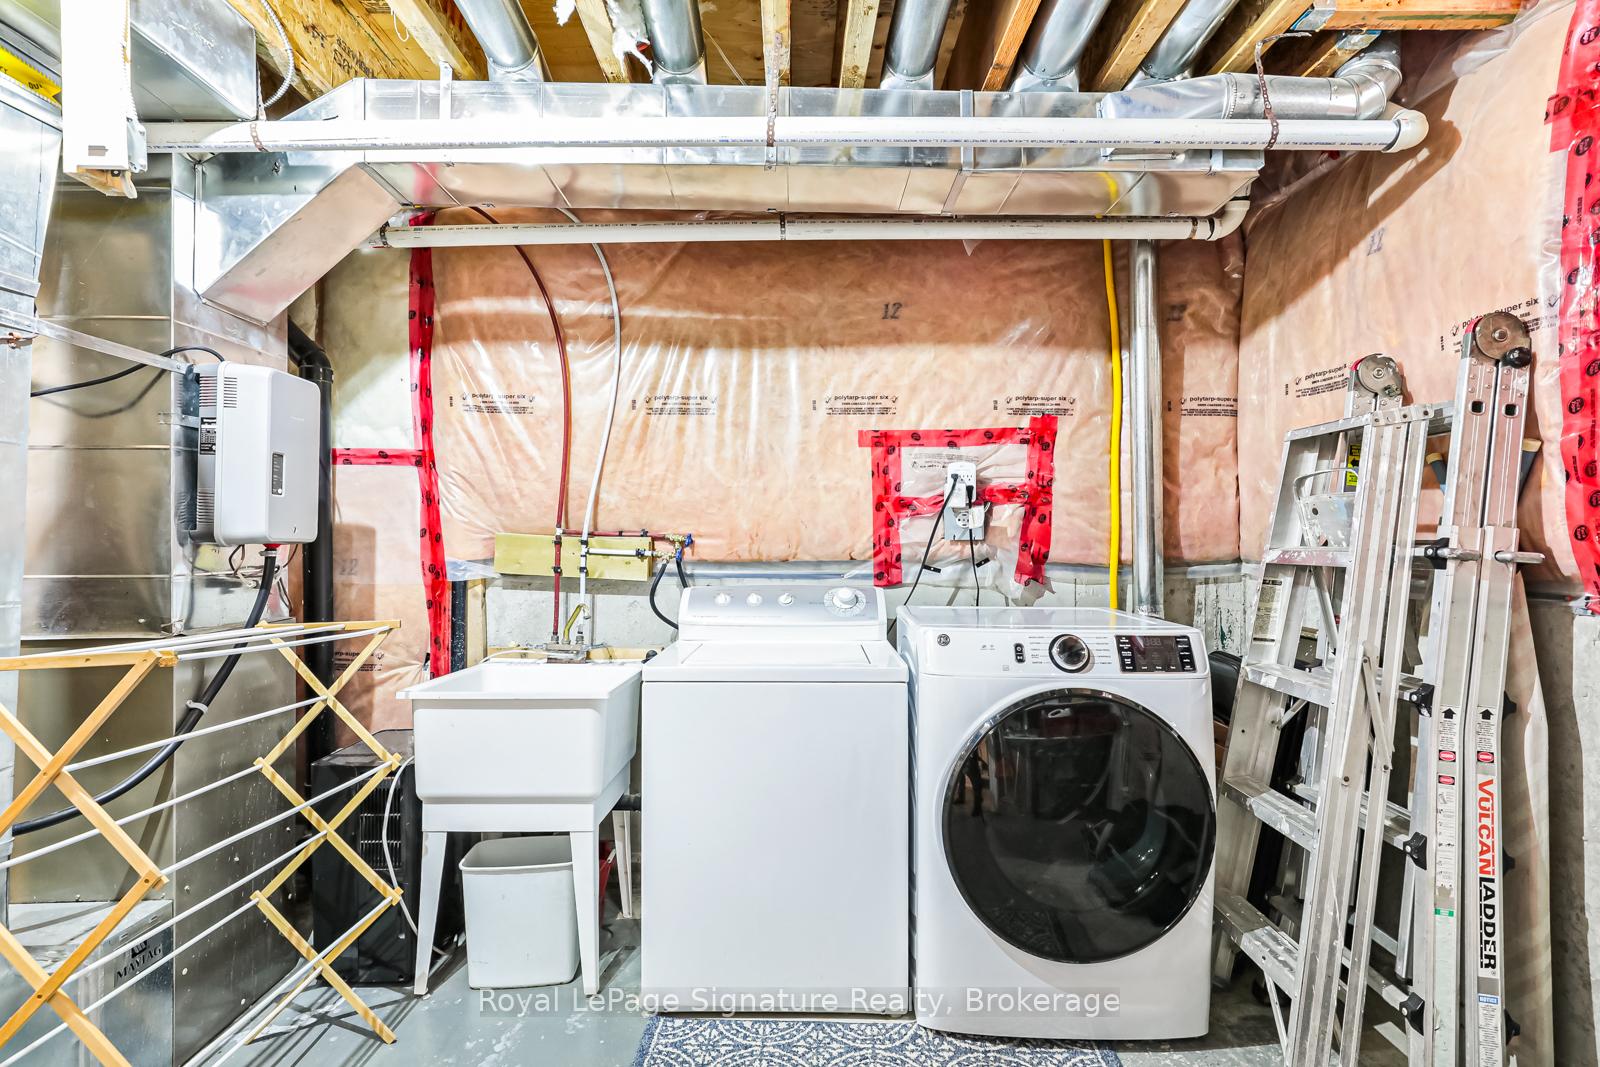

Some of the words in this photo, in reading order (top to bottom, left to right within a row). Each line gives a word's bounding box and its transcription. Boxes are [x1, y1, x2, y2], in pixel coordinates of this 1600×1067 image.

[882, 302, 903, 320] 12
[1525, 296, 1540, 307] six
[1477, 778, 1496, 876] VULCAN
[1478, 876, 1497, 970] LADDER
[116, 946, 162, 979] MAYTAG
